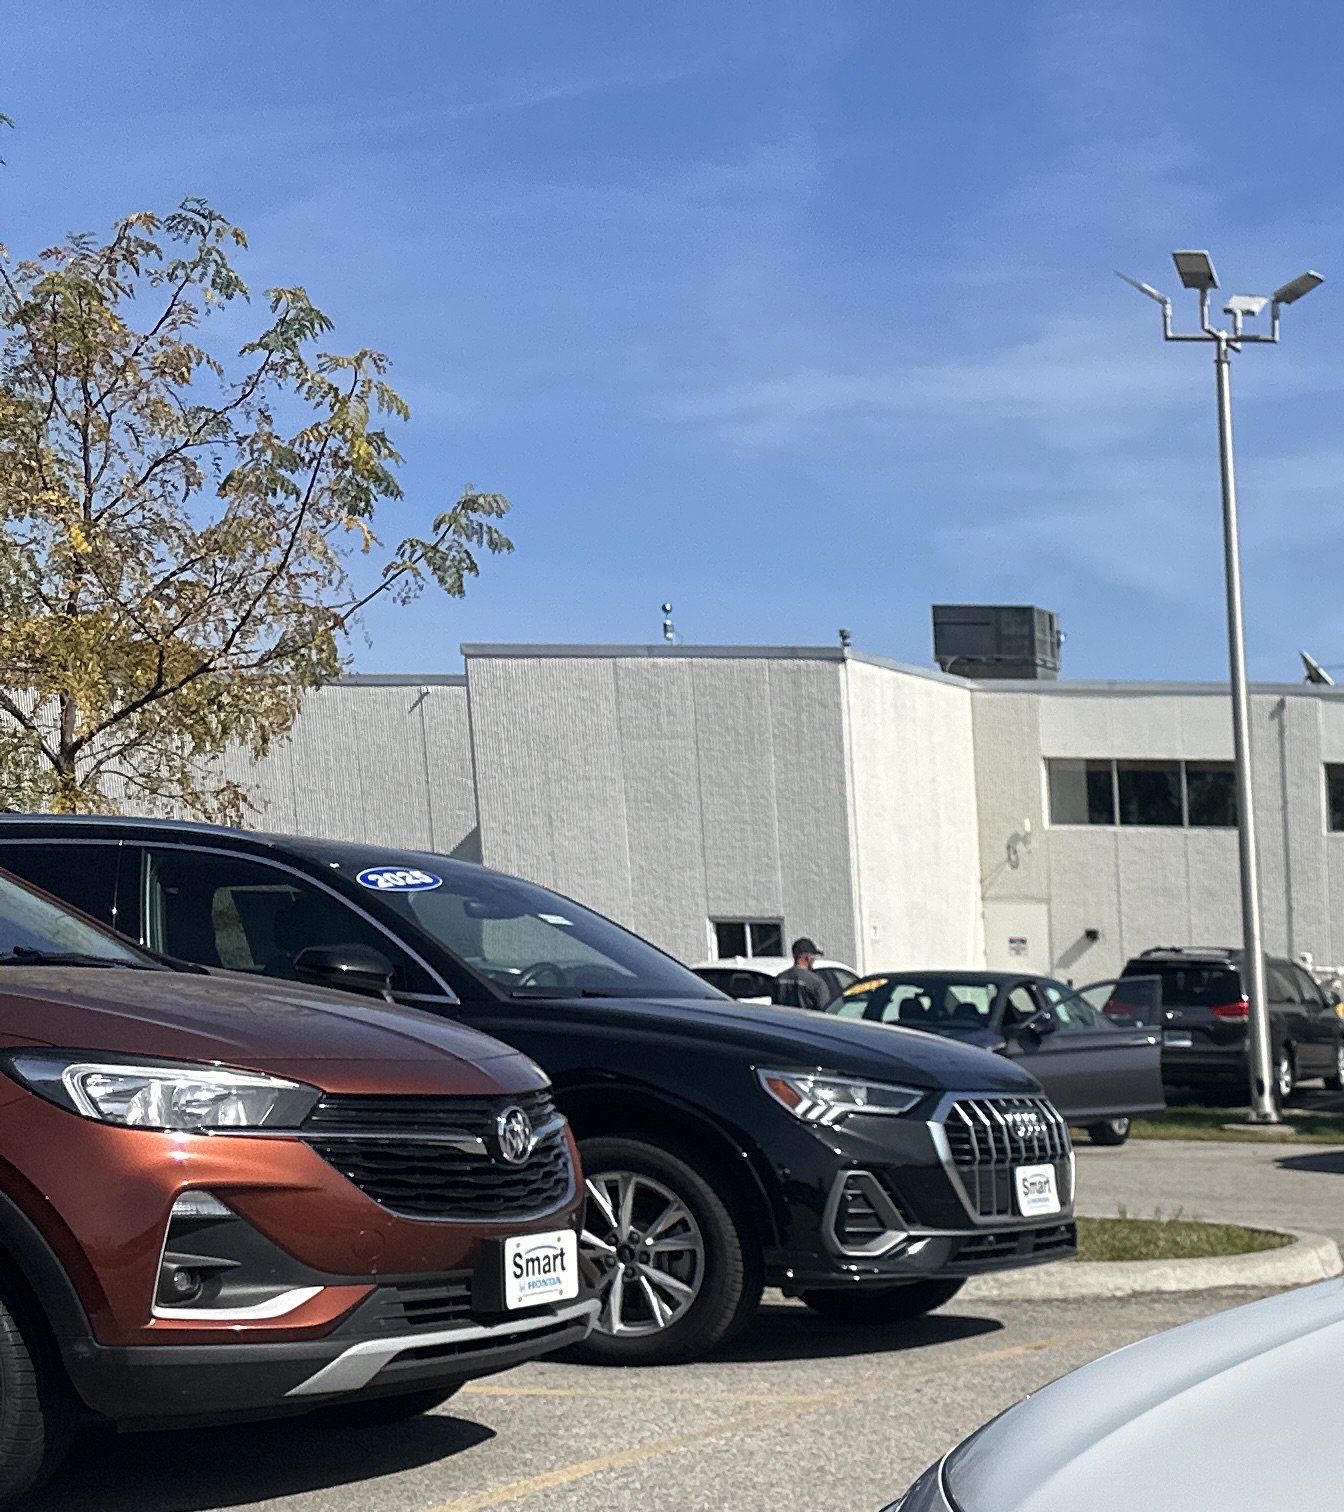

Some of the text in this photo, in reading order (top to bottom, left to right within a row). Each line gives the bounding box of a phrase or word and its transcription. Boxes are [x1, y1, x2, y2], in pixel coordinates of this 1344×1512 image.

[367, 870, 434, 888] 2025
[512, 1247, 567, 1279] Smart
[528, 1276, 562, 1290] HONDA
